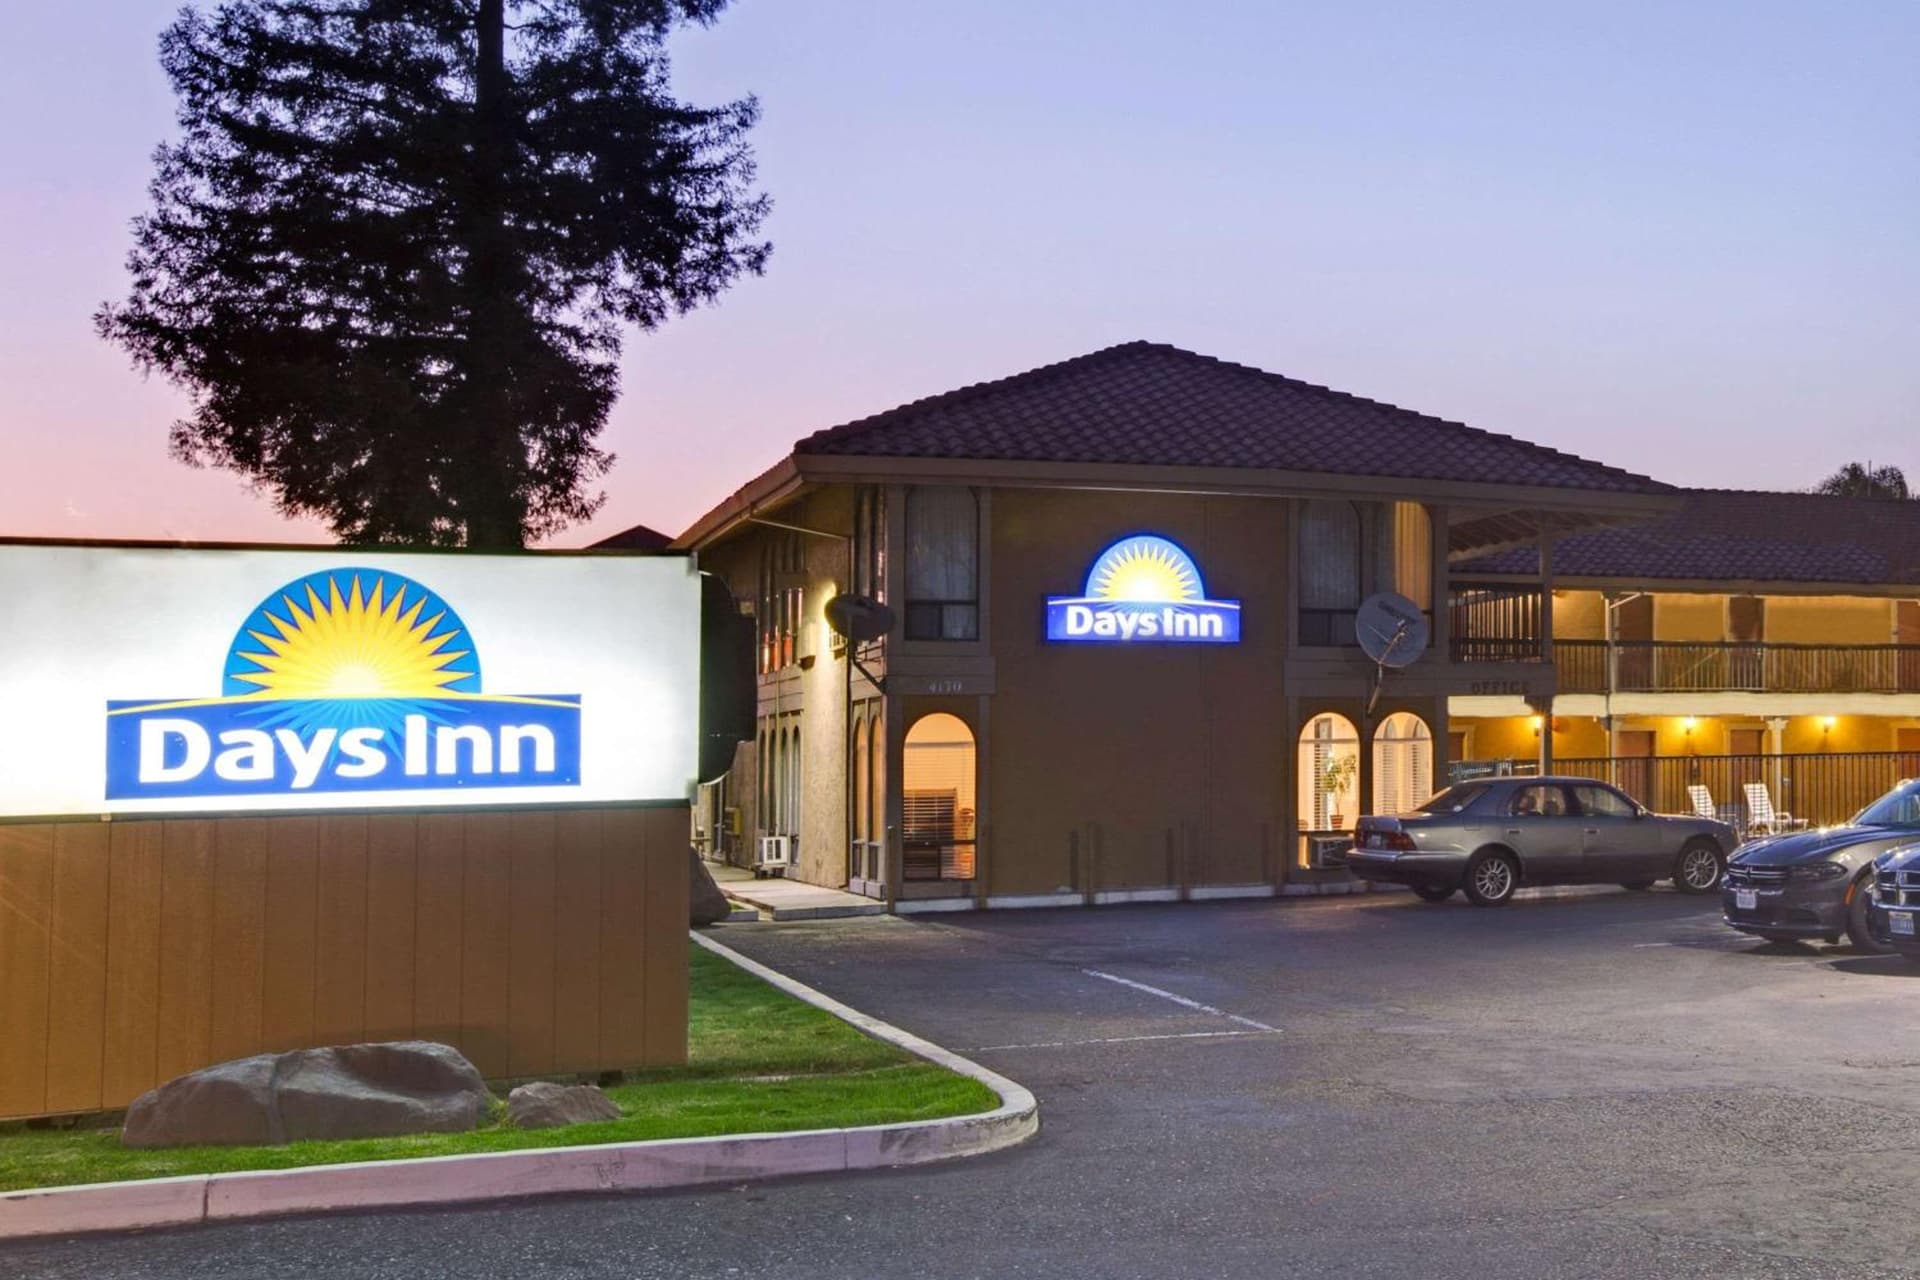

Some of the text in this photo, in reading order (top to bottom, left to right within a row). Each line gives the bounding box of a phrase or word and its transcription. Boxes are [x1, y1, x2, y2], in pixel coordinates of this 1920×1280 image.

[1066, 605, 1223, 640] Days Inn
[1472, 681, 1529, 694] OFFICE
[138, 714, 555, 788] Days Inn
